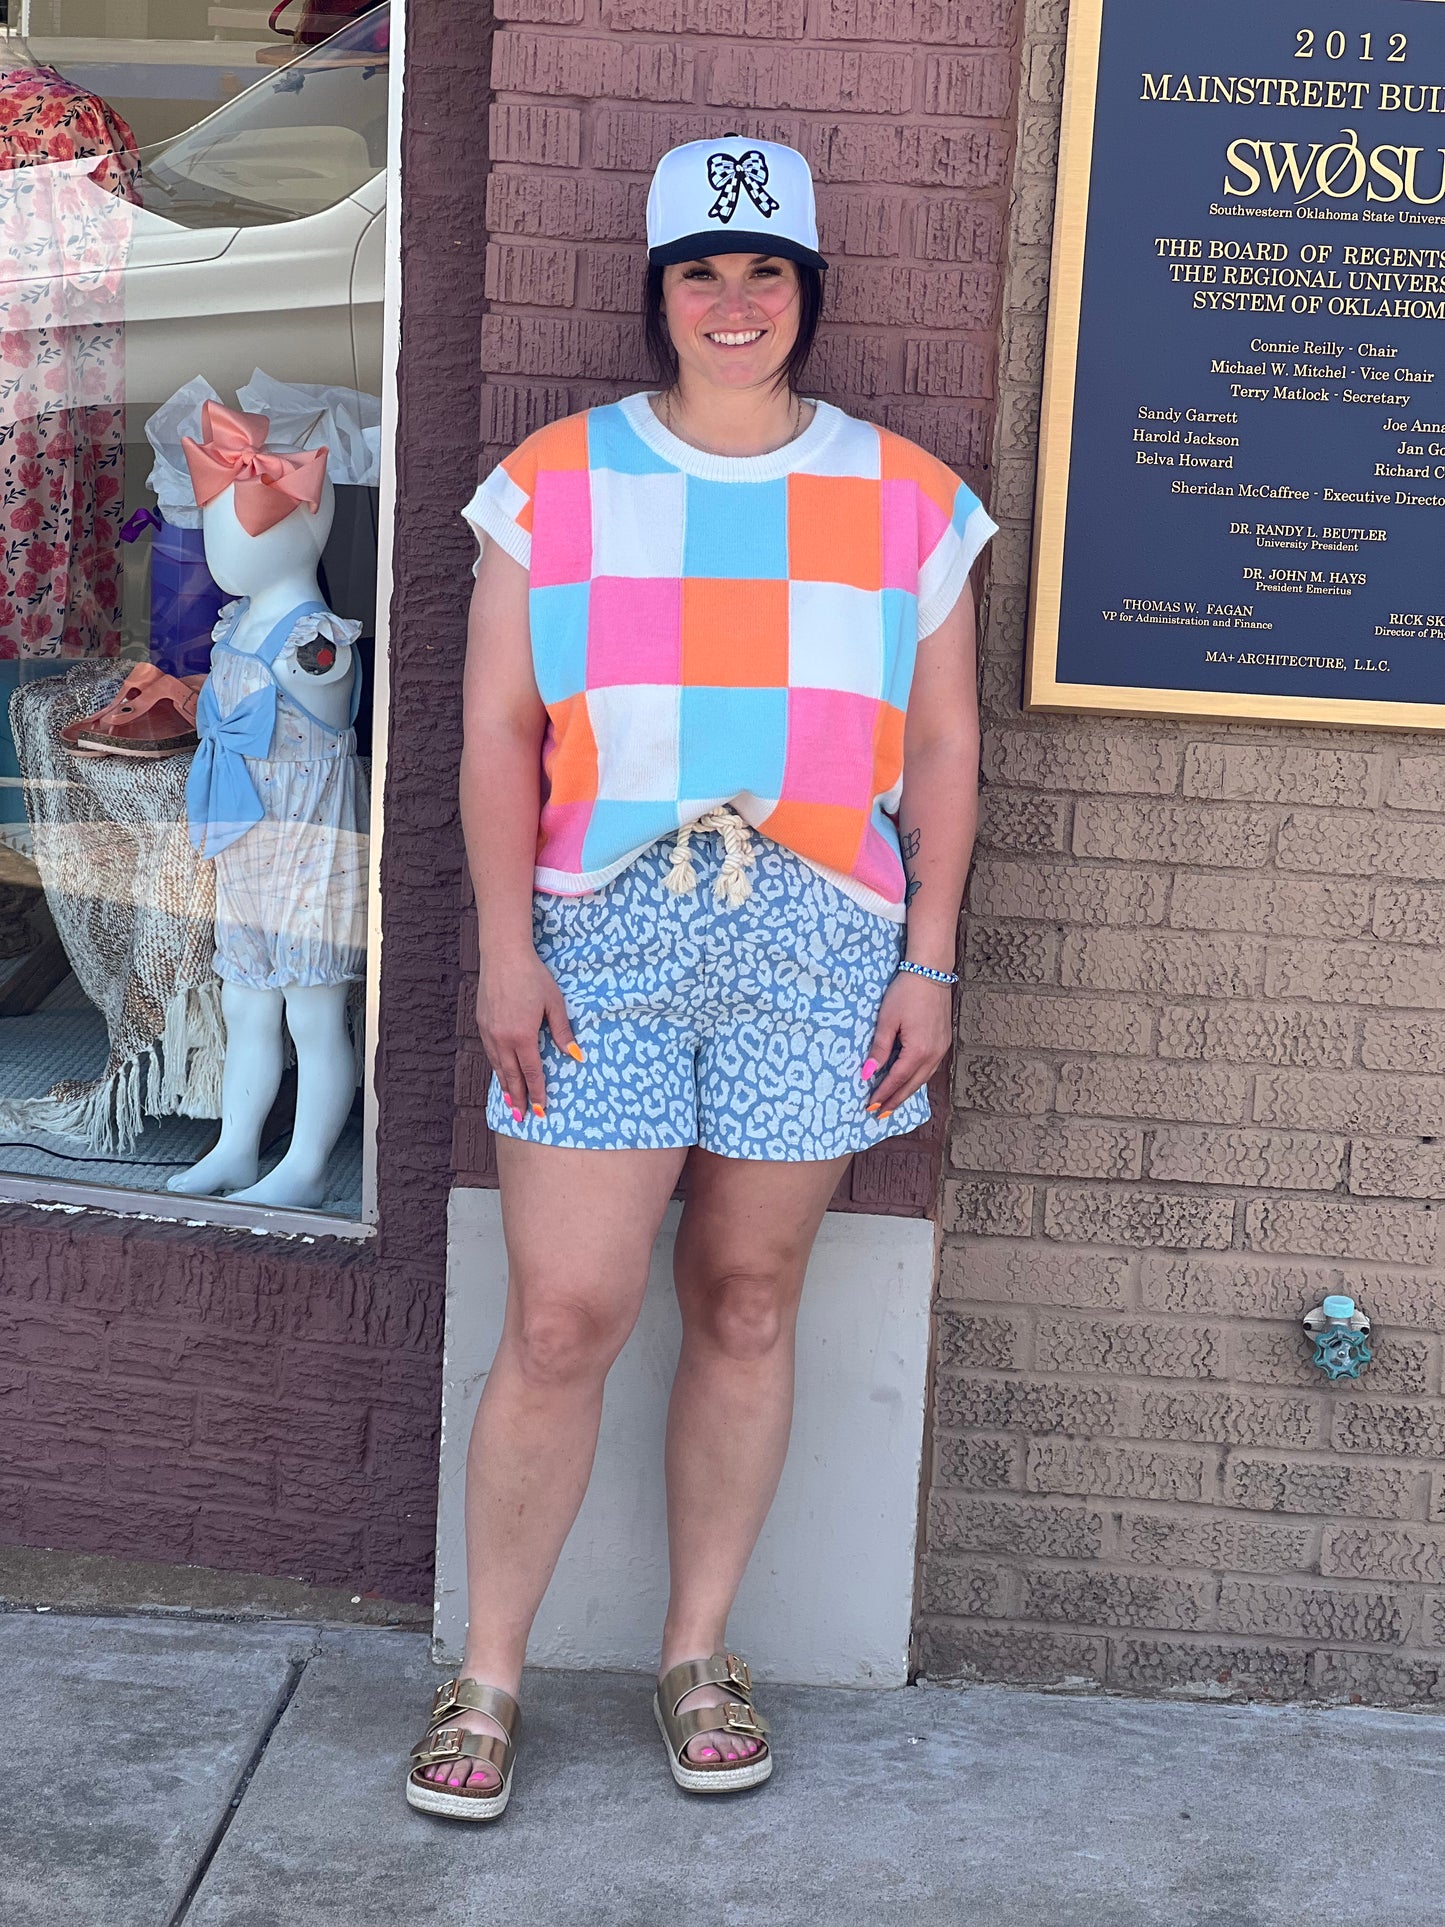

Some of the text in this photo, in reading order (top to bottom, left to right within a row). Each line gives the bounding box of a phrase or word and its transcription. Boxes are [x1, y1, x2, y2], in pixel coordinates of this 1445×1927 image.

[1294, 29, 1407, 62] 2012
[1140, 74, 1445, 113] MAINSTREET BUI
[1209, 203, 1293, 218] Southwestern
[1296, 207, 1359, 221] Oklahoma
[1362, 210, 1395, 222] State
[1155, 239, 1202, 257] THE
[1208, 241, 1288, 261] BOARD
[1300, 245, 1332, 263] OF
[1170, 264, 1216, 283] THE
[1222, 267, 1342, 288] REGIONAL
[1193, 291, 1445, 319] SYSTEM OF OKLAHOM
[1250, 339, 1300, 353] Connie
[1303, 341, 1344, 357] Reilly
[1357, 344, 1397, 357] Chair
[1211, 360, 1266, 375] Michael
[1271, 363, 1289, 376] W.
[1294, 365, 1346, 379] Mitchel
[1360, 367, 1390, 381] Vice
[1394, 369, 1434, 383] Chair
[1230, 385, 1269, 400] Terry
[1273, 387, 1329, 401] Matlock
[1342, 390, 1410, 407] Secretary
[1138, 407, 1237, 423] Sandy Garrett
[1383, 419, 1407, 432] Joe
[1133, 429, 1239, 446] Harold Jackson
[1397, 442, 1424, 455] Jan
[1136, 452, 1233, 468] Belva Howard
[1374, 463, 1429, 478] Richard
[1171, 481, 1233, 496] Sheridan
[1238, 485, 1309, 499] McCaffree
[1323, 489, 1390, 504] Executive
[1395, 492, 1445, 506] Directo
[1230, 523, 1387, 541] DR. RANDY L. BEUTLER
[1256, 538, 1359, 552] University President
[1243, 568, 1366, 585] DR. JOHN M. HAYS
[1255, 582, 1351, 595] President Emeritus
[1123, 599, 1253, 617] THOMAS W. FAGAN
[1102, 611, 1272, 630] VP for Administration and Finance
[1389, 613, 1423, 626] RICK
[1375, 627, 1415, 637] Director
[1418, 629, 1428, 638] of
[1237, 654, 1347, 671] ARCHITECTURE,
[1354, 660, 1390, 672] L.L.C.
